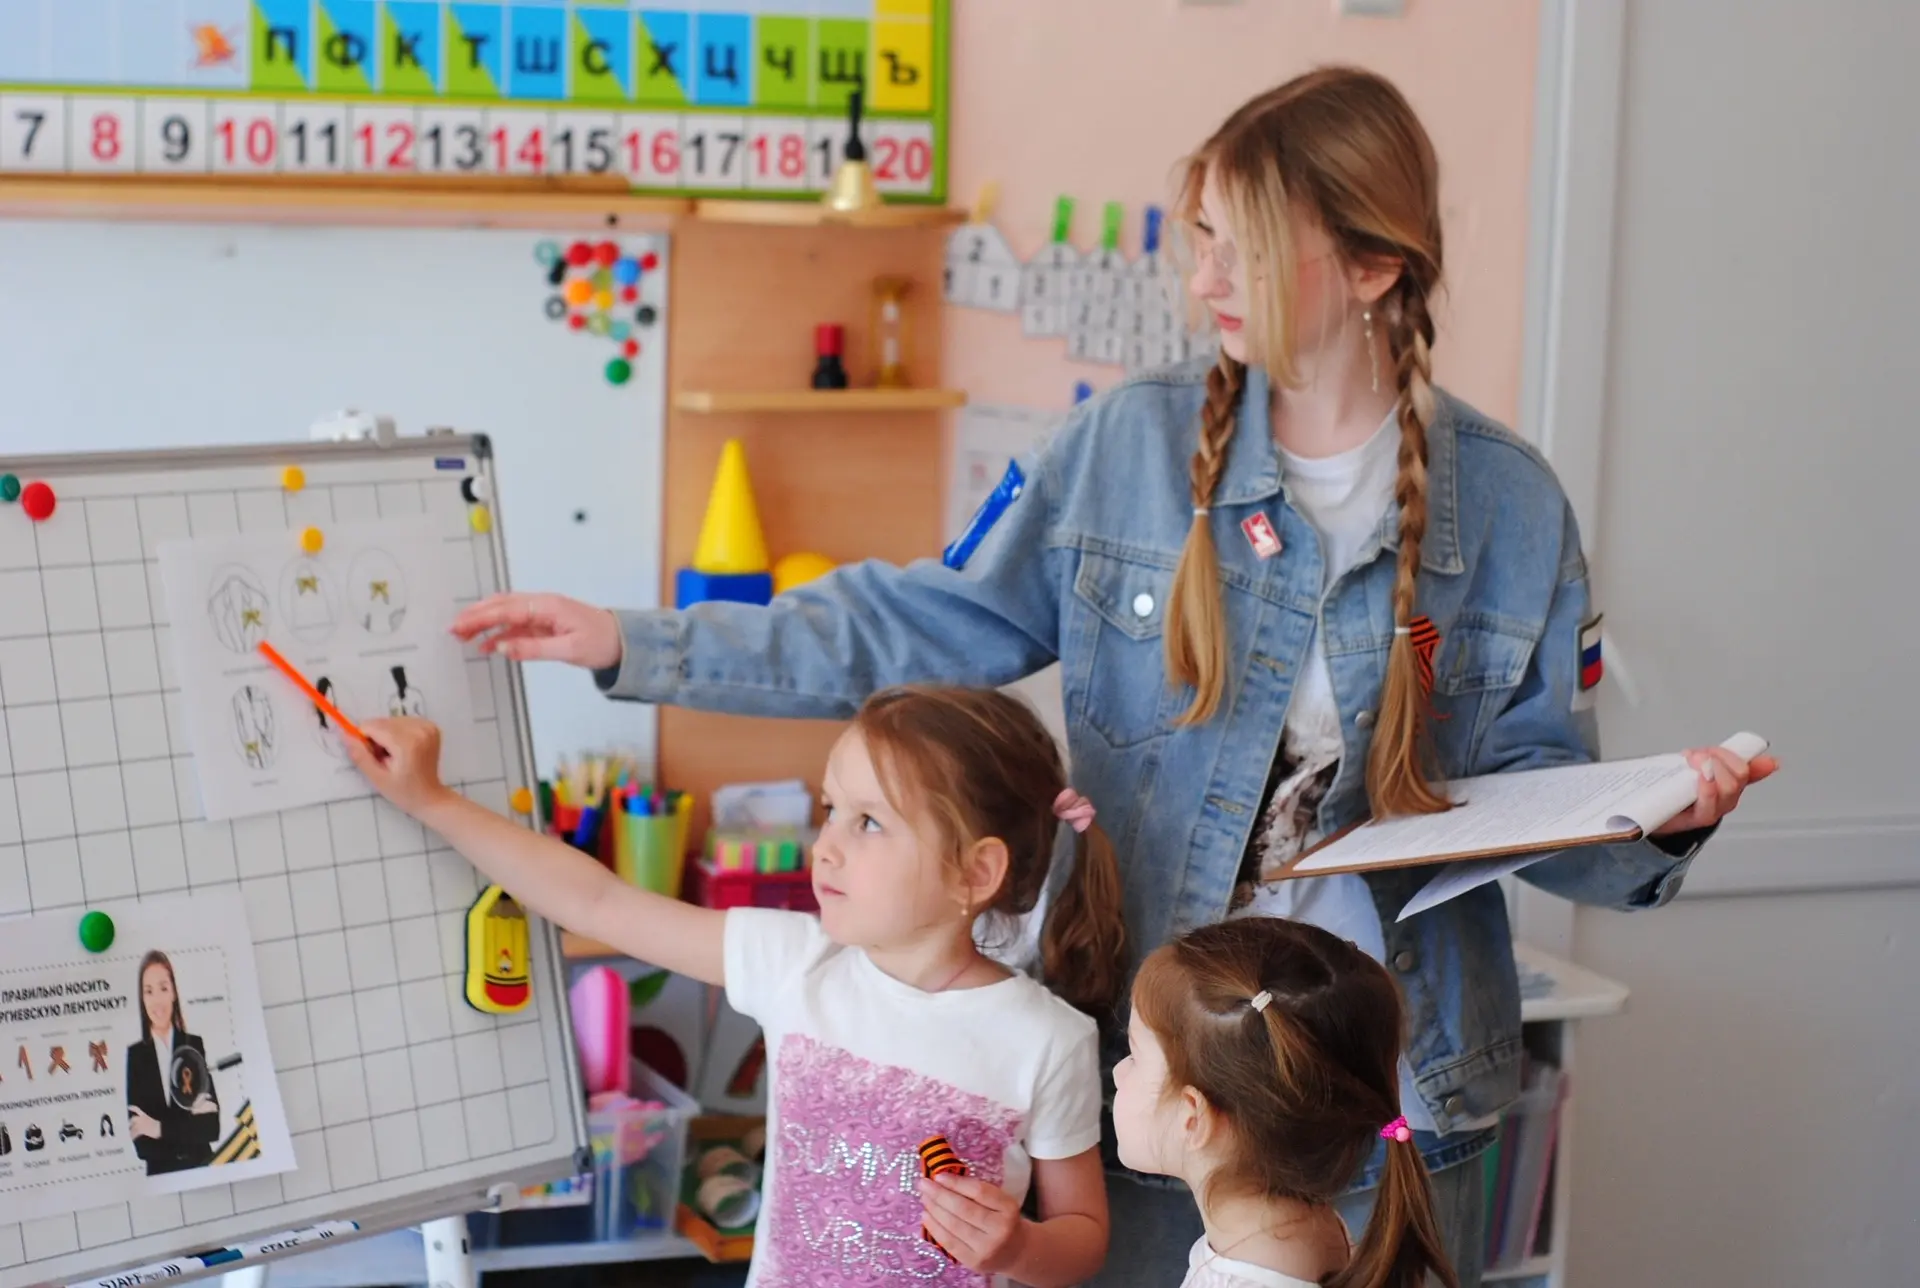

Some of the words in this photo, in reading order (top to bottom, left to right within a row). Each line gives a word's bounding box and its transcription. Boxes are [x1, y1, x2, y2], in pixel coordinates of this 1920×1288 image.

[266, 28, 295, 62] П
[325, 31, 366, 67] Ф
[395, 33, 421, 65] К
[461, 35, 489, 68] Т
[515, 36, 559, 74] Ш
[582, 40, 611, 75] С
[648, 42, 678, 76] Х
[705, 43, 739, 84] Ц
[764, 46, 795, 79] Ч
[820, 48, 864, 88] Щ
[882, 50, 920, 84] Ъ
[16, 111, 45, 158] 7
[90, 112, 120, 161] 8
[162, 115, 191, 162] 9
[217, 117, 277, 164] 10
[289, 120, 337, 165] 11
[356, 122, 414, 168] 12
[425, 124, 484, 169] 13
[488, 127, 545, 173] 14
[555, 129, 611, 173] 15
[625, 131, 680, 174] 16
[689, 133, 743, 176] 17
[750, 134, 805, 177] 18
[874, 137, 932, 181] 20
[1, 984, 63, 1003] ПРАВИЛЬНО
[65, 979, 111, 996] НОСИТЬ
[63, 995, 127, 1015] ЛЕНТОЧКУ?
